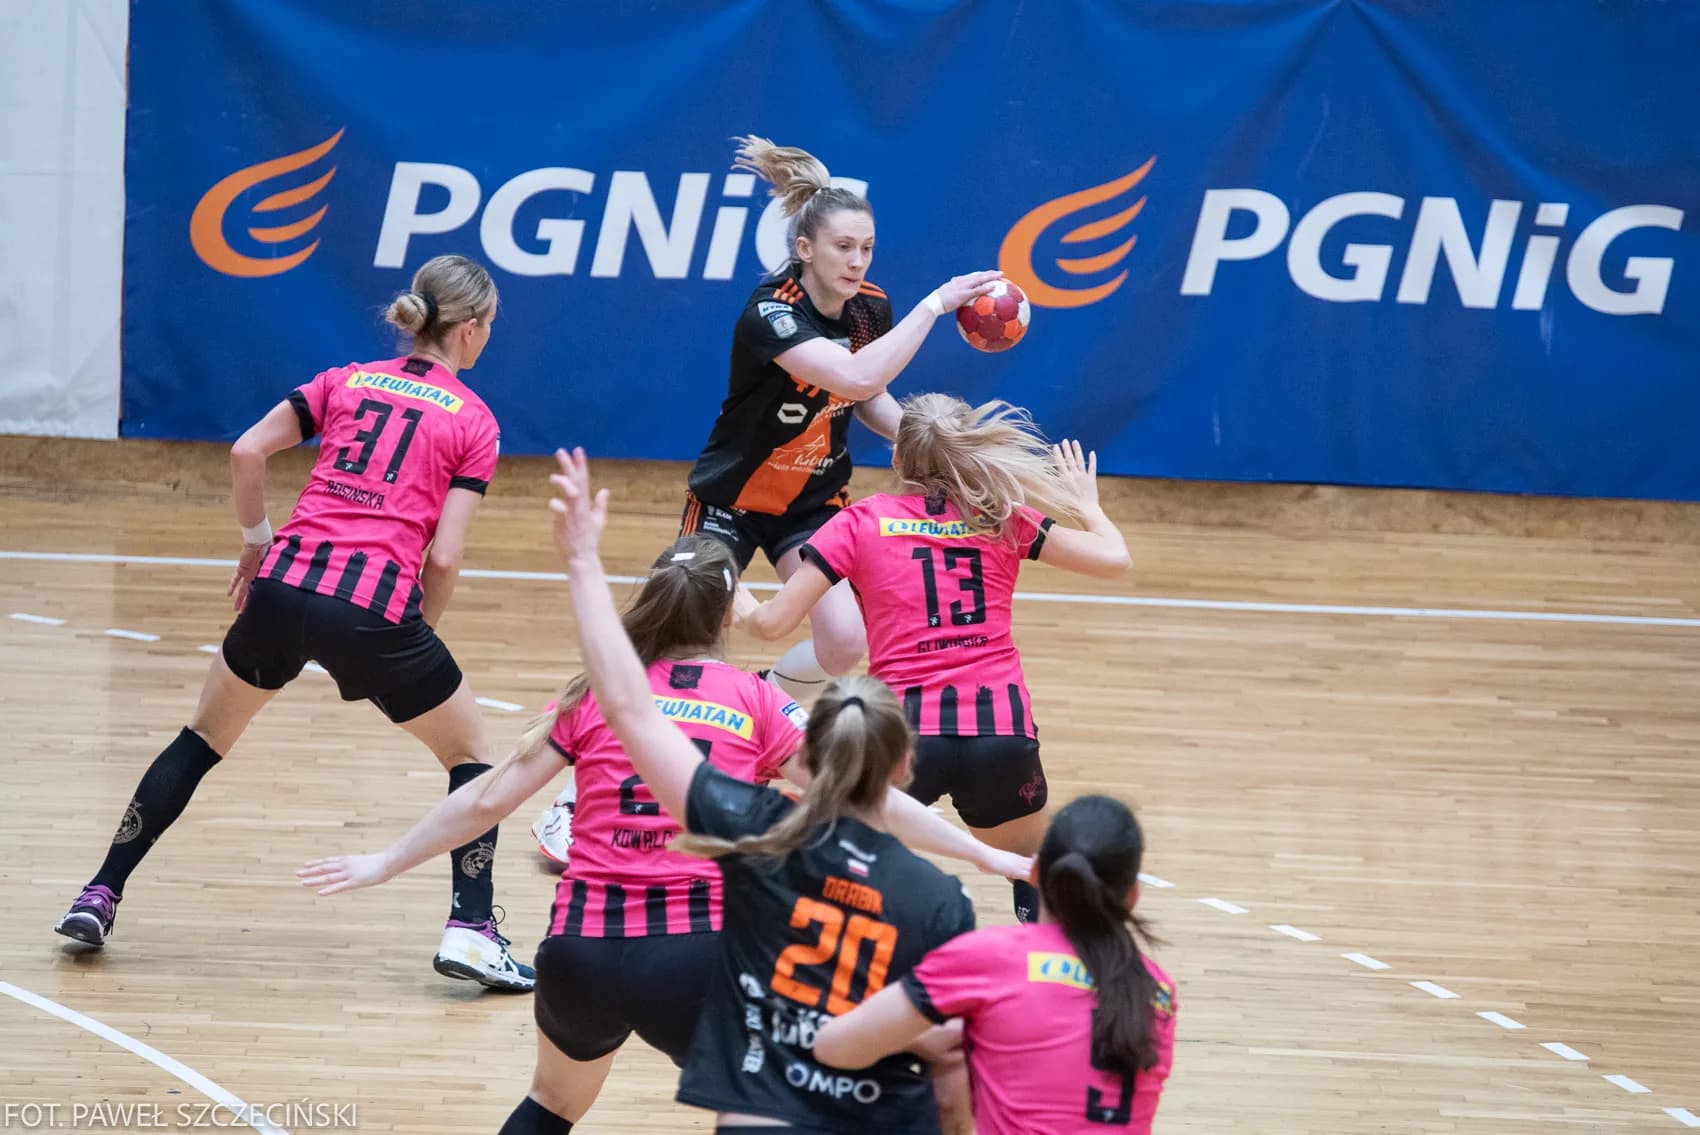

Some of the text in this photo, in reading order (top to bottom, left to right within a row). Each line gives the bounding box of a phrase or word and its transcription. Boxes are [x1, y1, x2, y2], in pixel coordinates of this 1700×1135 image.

[1180, 188, 1685, 315] PGNiG
[370, 375, 456, 408] LEWIATAN
[333, 398, 424, 484] 31
[911, 522, 976, 537] LEWIAT
[911, 547, 986, 628] 13
[610, 828, 674, 849] KOWALC
[769, 896, 898, 1016] 20
